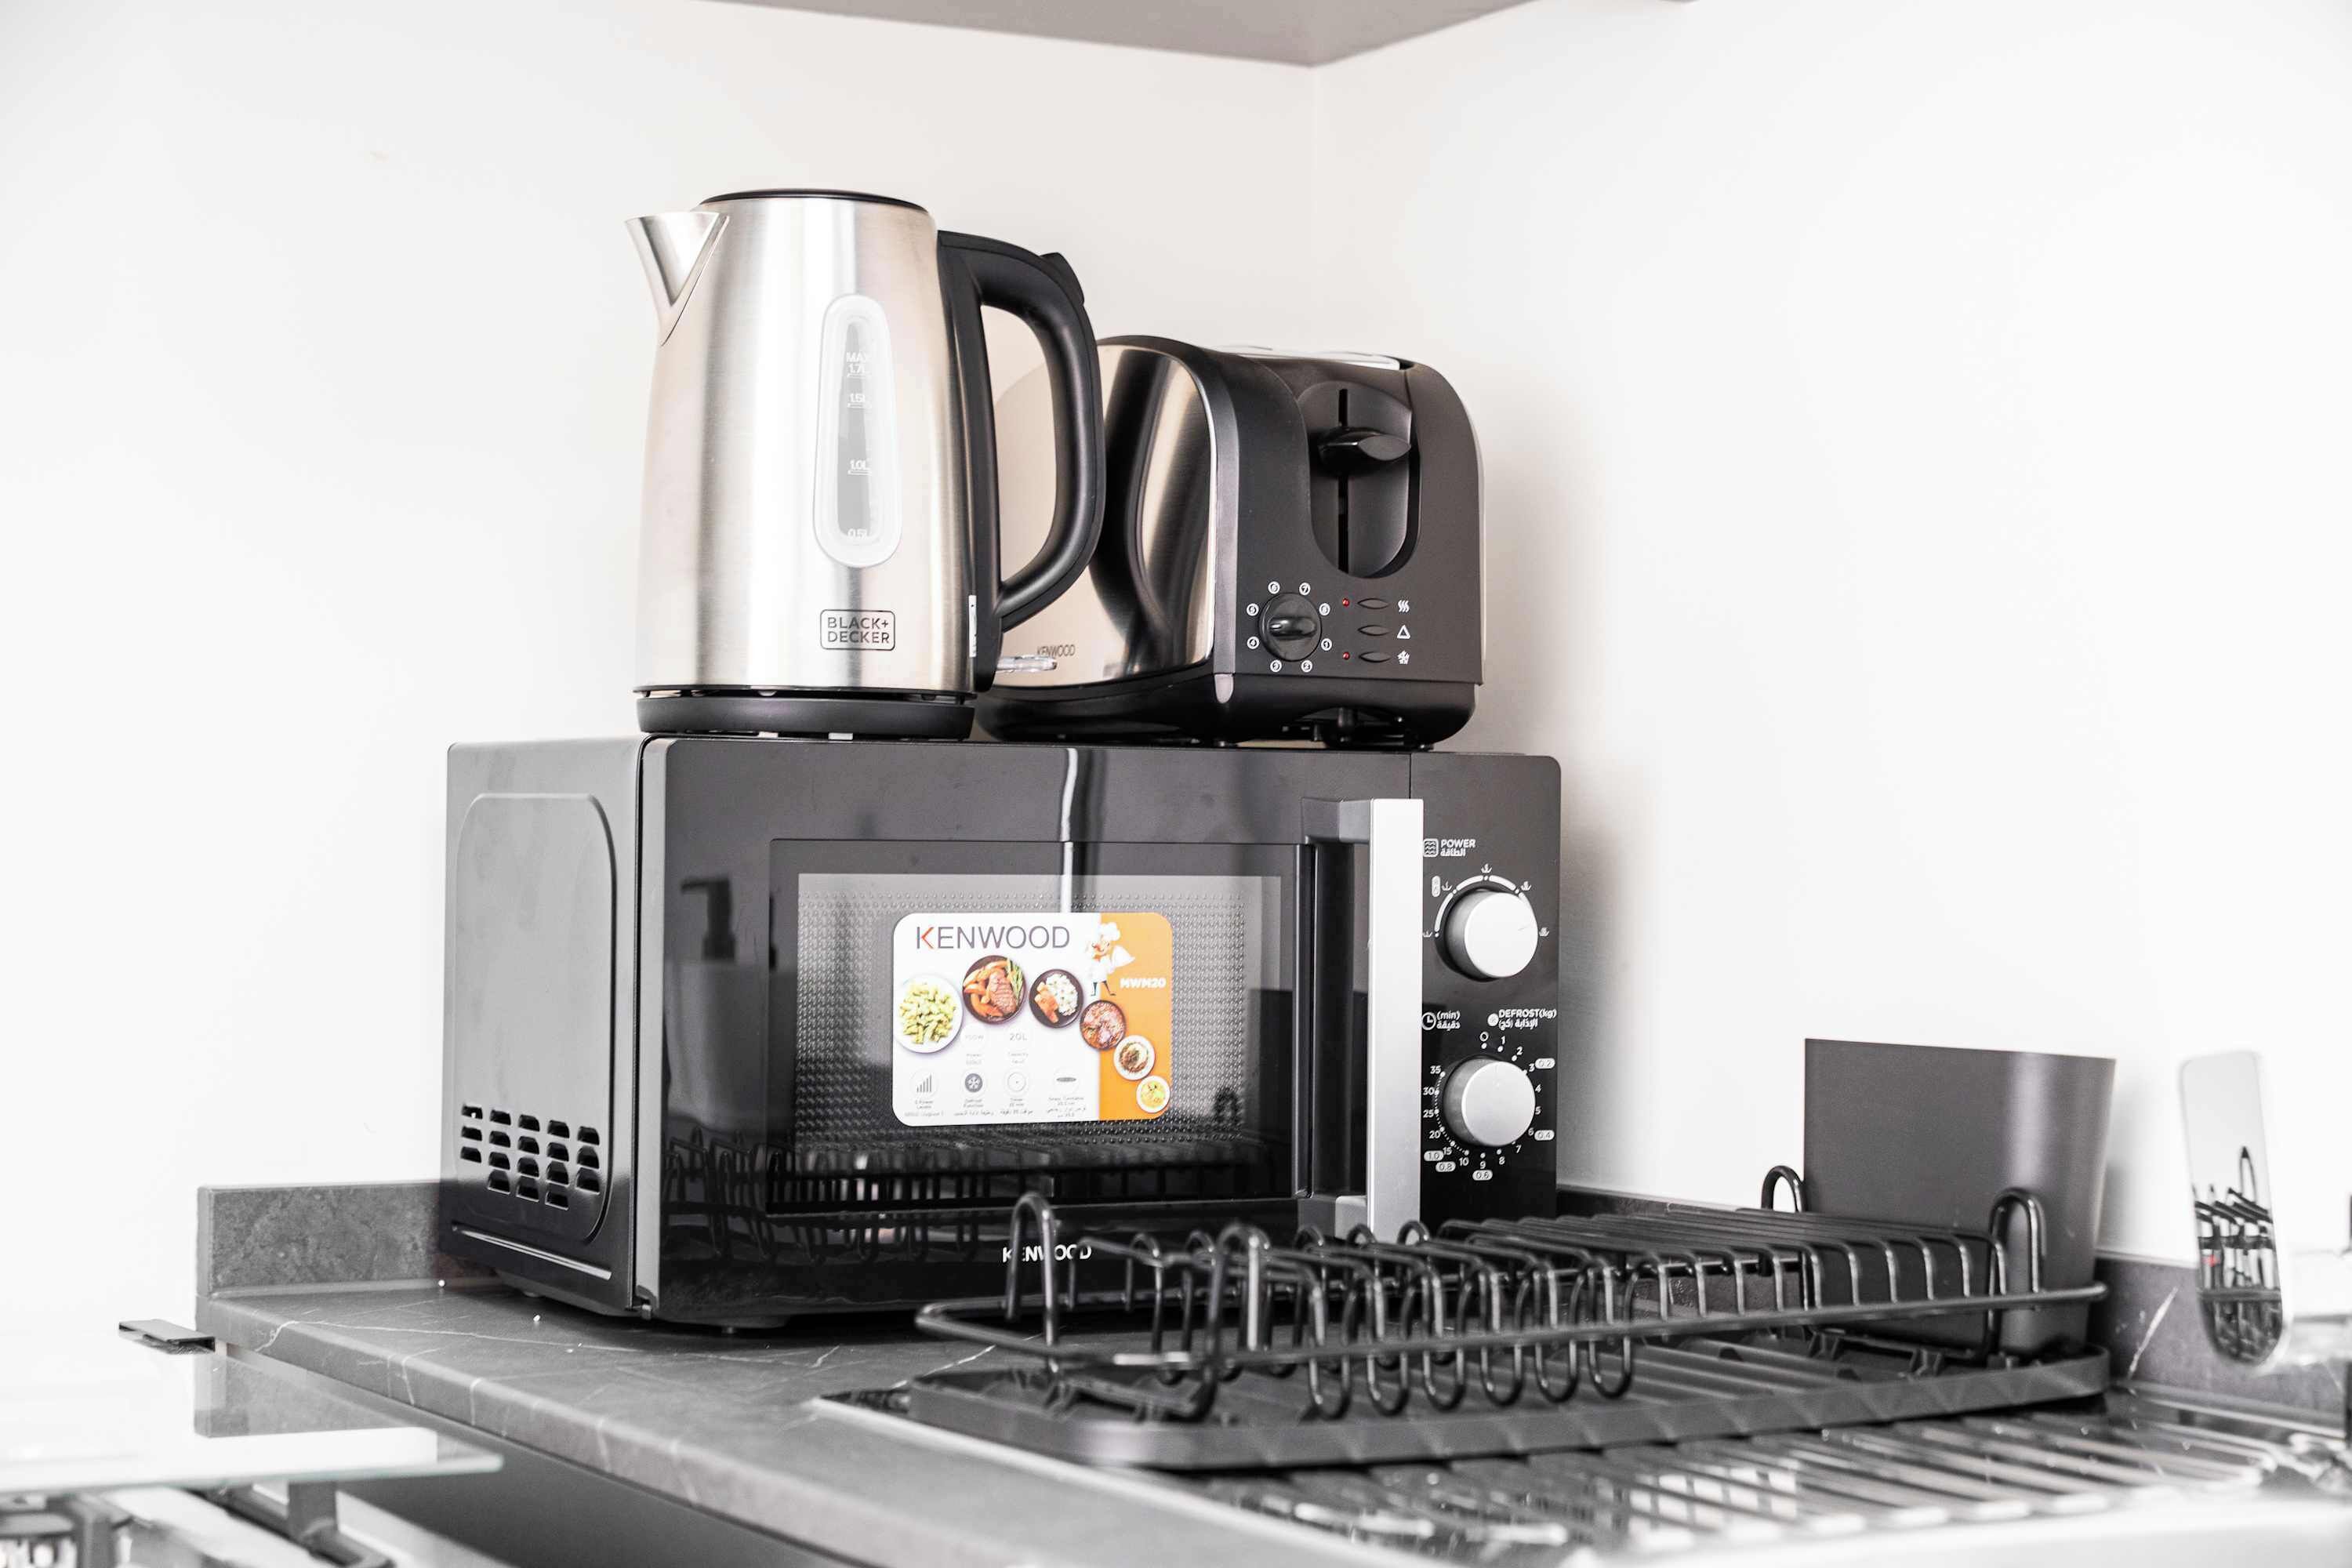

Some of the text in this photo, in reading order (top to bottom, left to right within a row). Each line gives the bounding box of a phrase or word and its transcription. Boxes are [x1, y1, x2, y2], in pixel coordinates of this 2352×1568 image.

[827, 616, 889, 629] BLACK+
[827, 630, 890, 644] DECKER
[1036, 644, 1076, 657] KENWOOD
[1440, 839, 1476, 848] POWER
[916, 925, 1070, 950] KENWOOD
[1436, 1011, 1461, 1020] (min)
[1498, 1008, 1557, 1019] DEFROST(kg)
[1479, 1032, 1489, 1041] 0
[1501, 1036, 1506, 1045] 1
[1516, 1046, 1523, 1056] 2
[1429, 1065, 1442, 1075] 35
[1529, 1063, 1535, 1073] 3
[1423, 1087, 1435, 1096] 30
[1535, 1083, 1543, 1093] 4
[1423, 1107, 1434, 1118] 25
[1535, 1106, 1542, 1115] 5
[1428, 1131, 1441, 1139] 20
[1528, 1127, 1535, 1136] 6
[1443, 1146, 1453, 1156] 15
[1515, 1144, 1522, 1154] 7
[1458, 1157, 1469, 1167] 10
[1479, 1160, 1486, 1170] 9
[1498, 1156, 1505, 1165] 8
[1003, 1243, 1092, 1263] KNOOD
